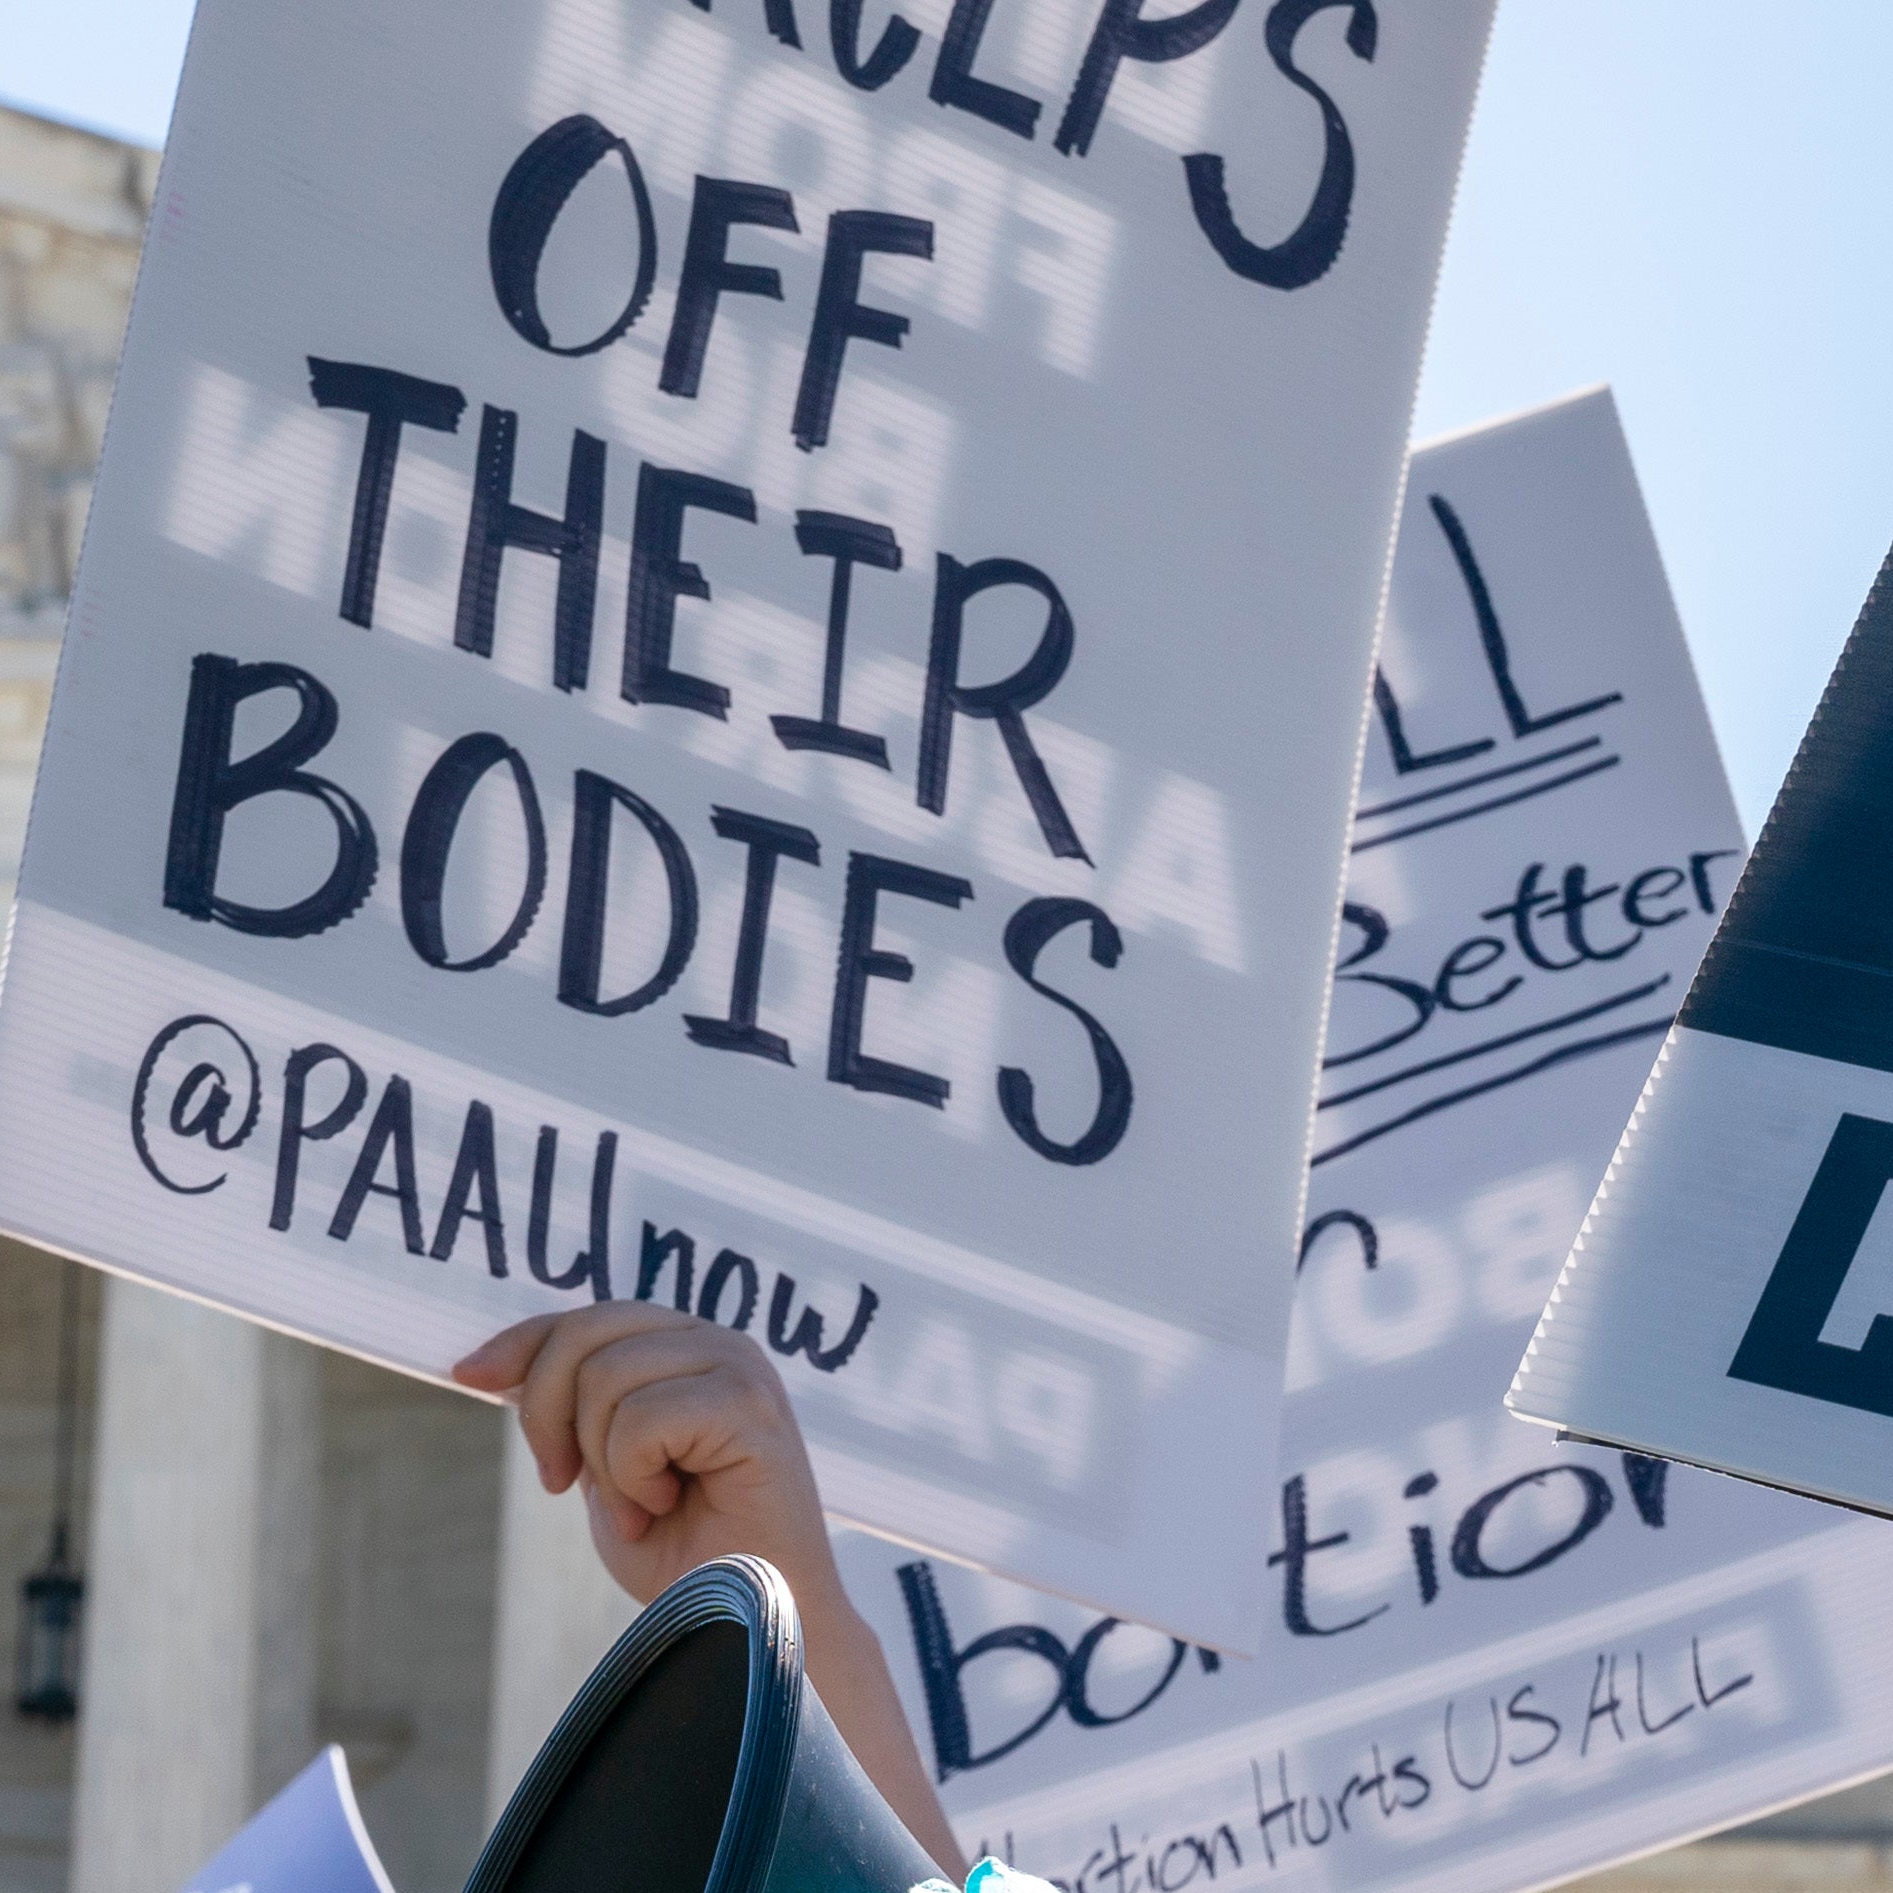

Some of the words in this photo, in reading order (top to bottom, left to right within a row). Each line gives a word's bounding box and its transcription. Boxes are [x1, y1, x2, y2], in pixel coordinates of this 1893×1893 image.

[488, 113, 935, 452] OFF
[308, 355, 1093, 867] THEIR
[1374, 493, 1623, 776] LL
[163, 652, 1133, 1167] BODIES
[1320, 850, 1740, 1069] Better
[1250, 1743, 1431, 1870] Hurts
[1445, 1686, 1562, 1791] US
[1581, 1636, 1754, 1756] ALL
